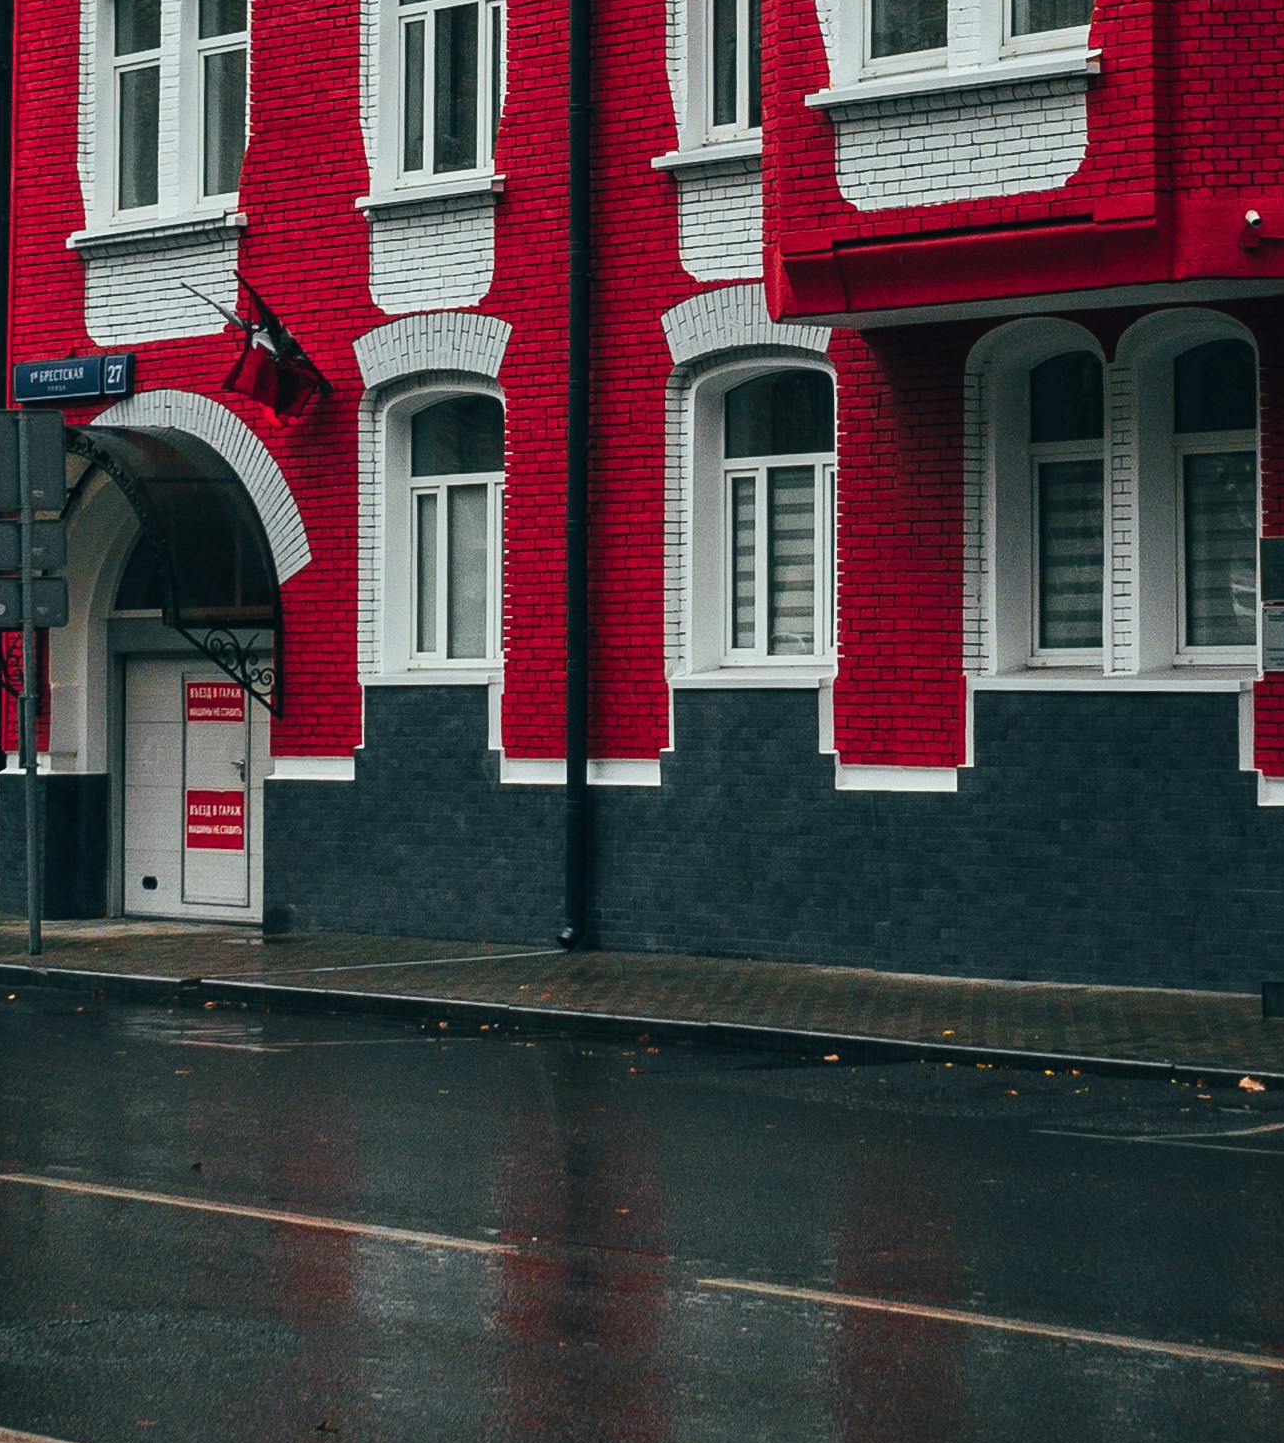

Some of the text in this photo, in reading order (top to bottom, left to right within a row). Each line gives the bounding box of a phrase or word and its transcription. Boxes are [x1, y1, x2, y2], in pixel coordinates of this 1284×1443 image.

[39, 367, 84, 383] БРЕСТСКАЯ
[107, 364, 123, 384] 27
[189, 687, 242, 699] ВЪЕЗД В ГАРАЖ
[189, 804, 242, 818] ВЪЕЗД В ГАРАЖ
